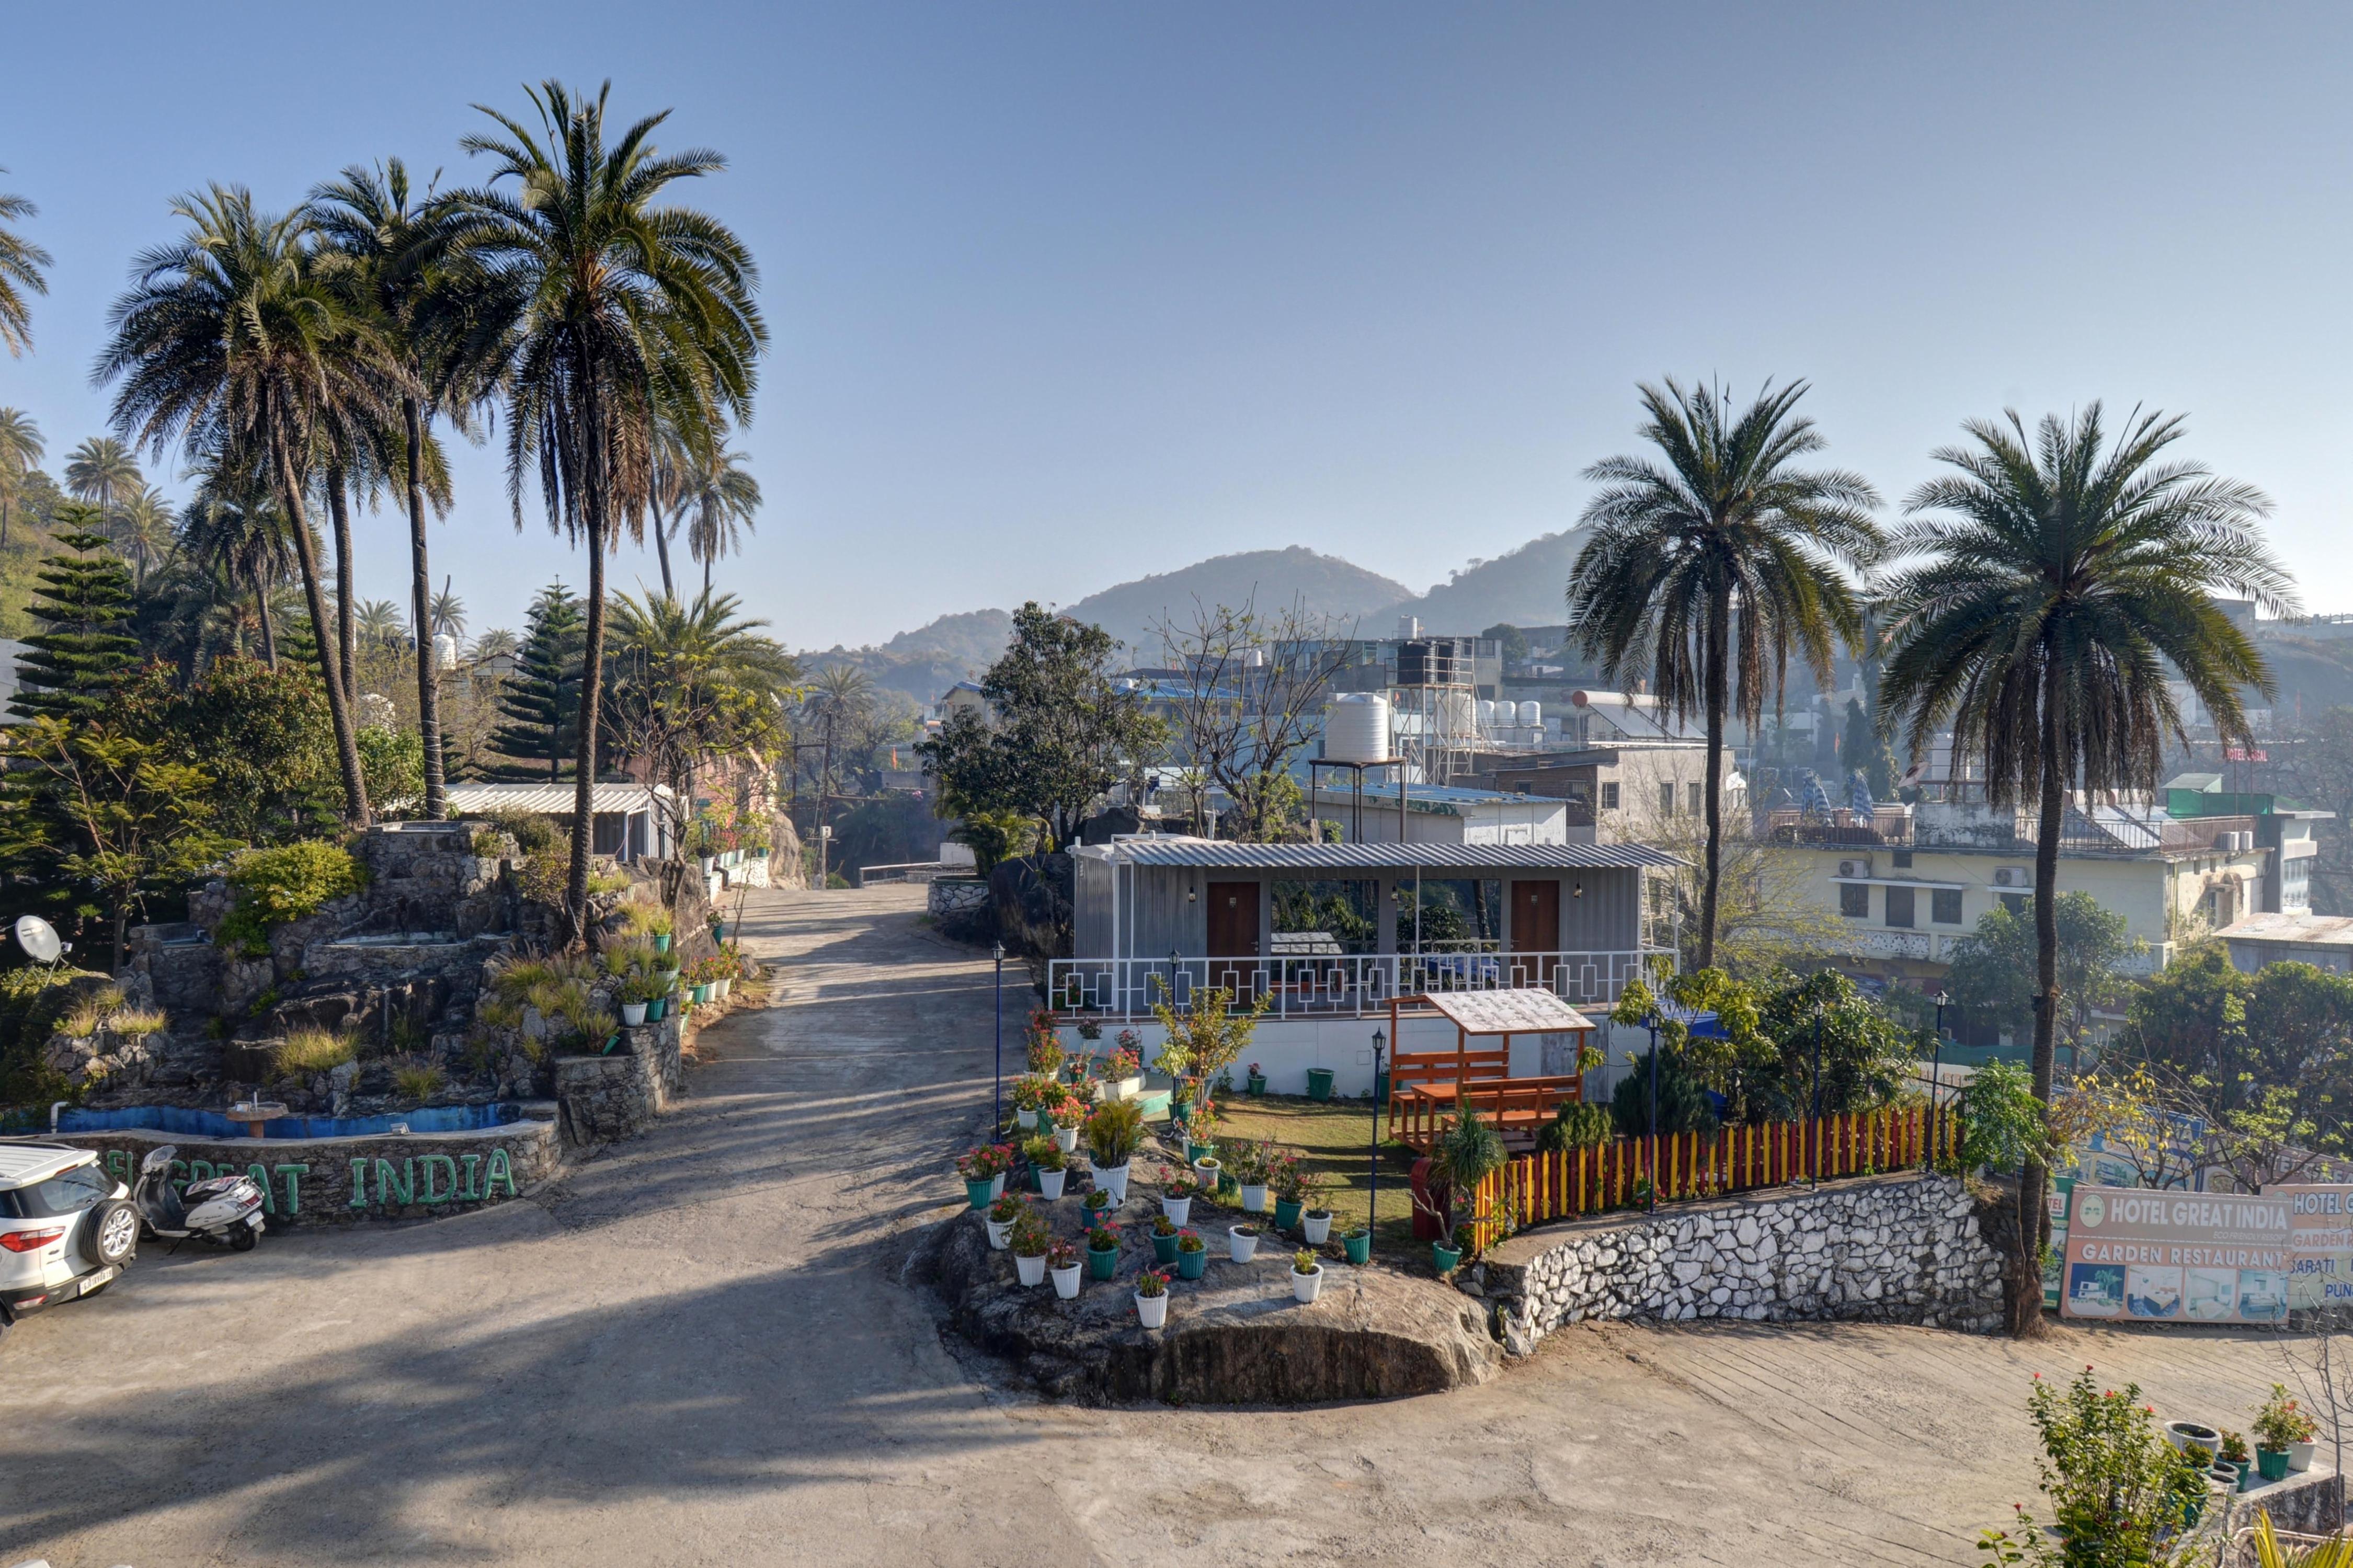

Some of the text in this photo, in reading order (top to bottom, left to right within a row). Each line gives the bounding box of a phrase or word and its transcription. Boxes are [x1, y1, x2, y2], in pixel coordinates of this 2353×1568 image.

[349, 1148, 515, 1208] INDIA
[2111, 1198, 2288, 1230] HOTEL GREAT INDIA
[2293, 1193, 2343, 1215] HOTEL
[2213, 1231, 2229, 1239] ECO
[2229, 1232, 2261, 1240] FRIENDLY
[2293, 1234, 2343, 1247] GARDEN
[2082, 1243, 2283, 1268] GARDEN RESTAURANT
[2326, 1284, 2353, 1298] PUN
